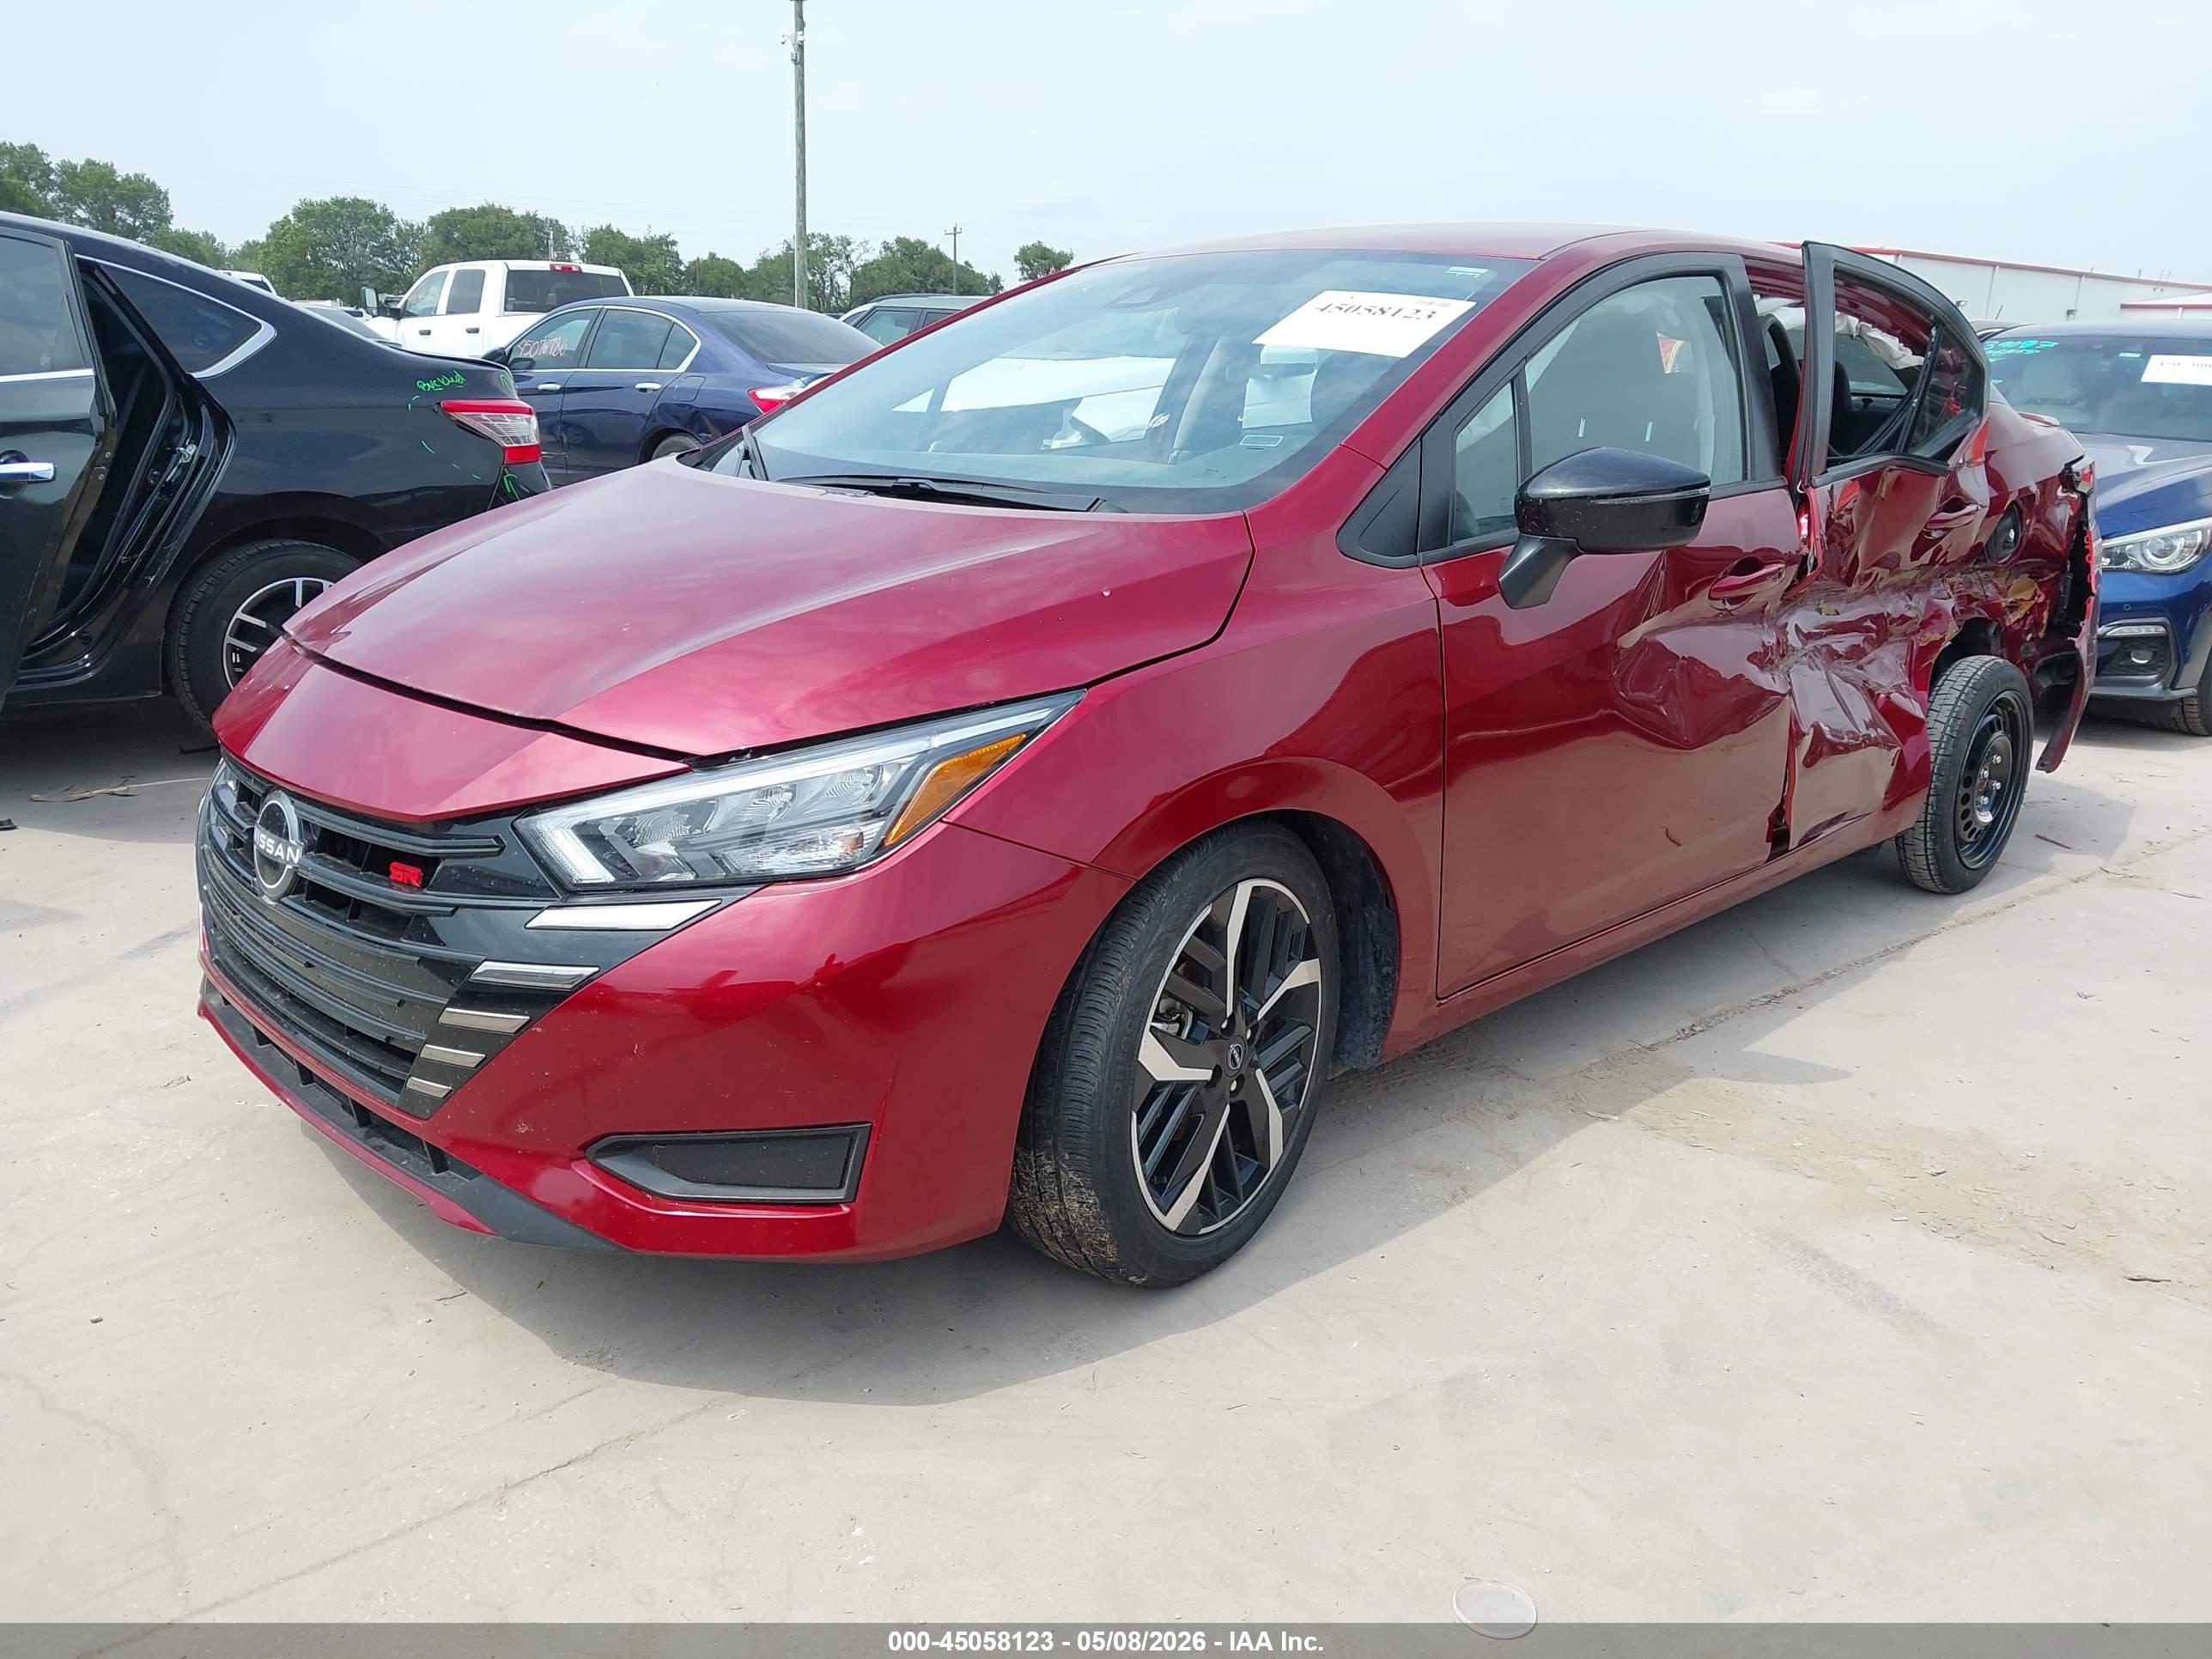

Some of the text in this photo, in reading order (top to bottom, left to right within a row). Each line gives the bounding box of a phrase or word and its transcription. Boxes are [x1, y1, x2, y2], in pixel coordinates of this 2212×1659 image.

[1315, 302, 1437, 320] 45058123
[256, 830, 300, 865] ISSAN
[389, 861, 422, 888] SR
